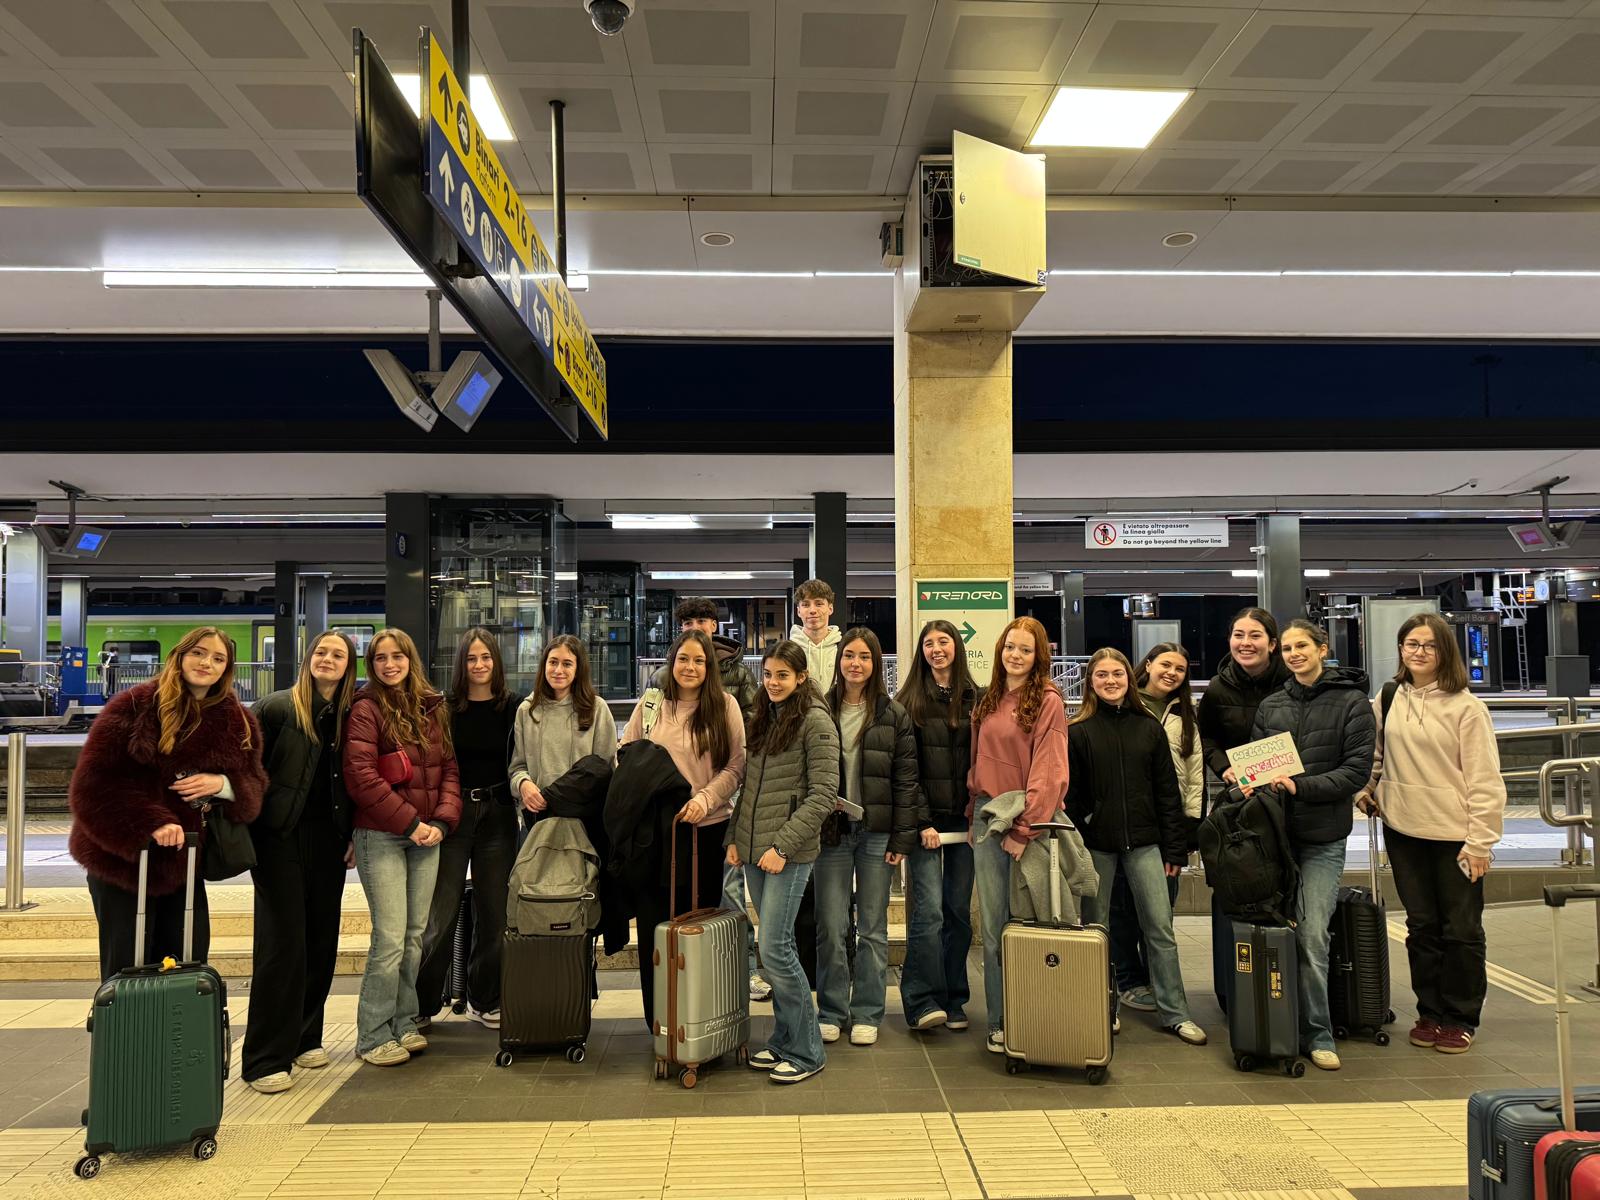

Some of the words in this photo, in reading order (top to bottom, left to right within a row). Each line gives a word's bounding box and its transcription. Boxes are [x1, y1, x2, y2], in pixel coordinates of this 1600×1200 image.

[475, 128, 500, 190] Binari
[503, 182, 527, 247] 2-16
[932, 591, 1003, 600] TRENORD
[1232, 739, 1286, 761] WELCOME
